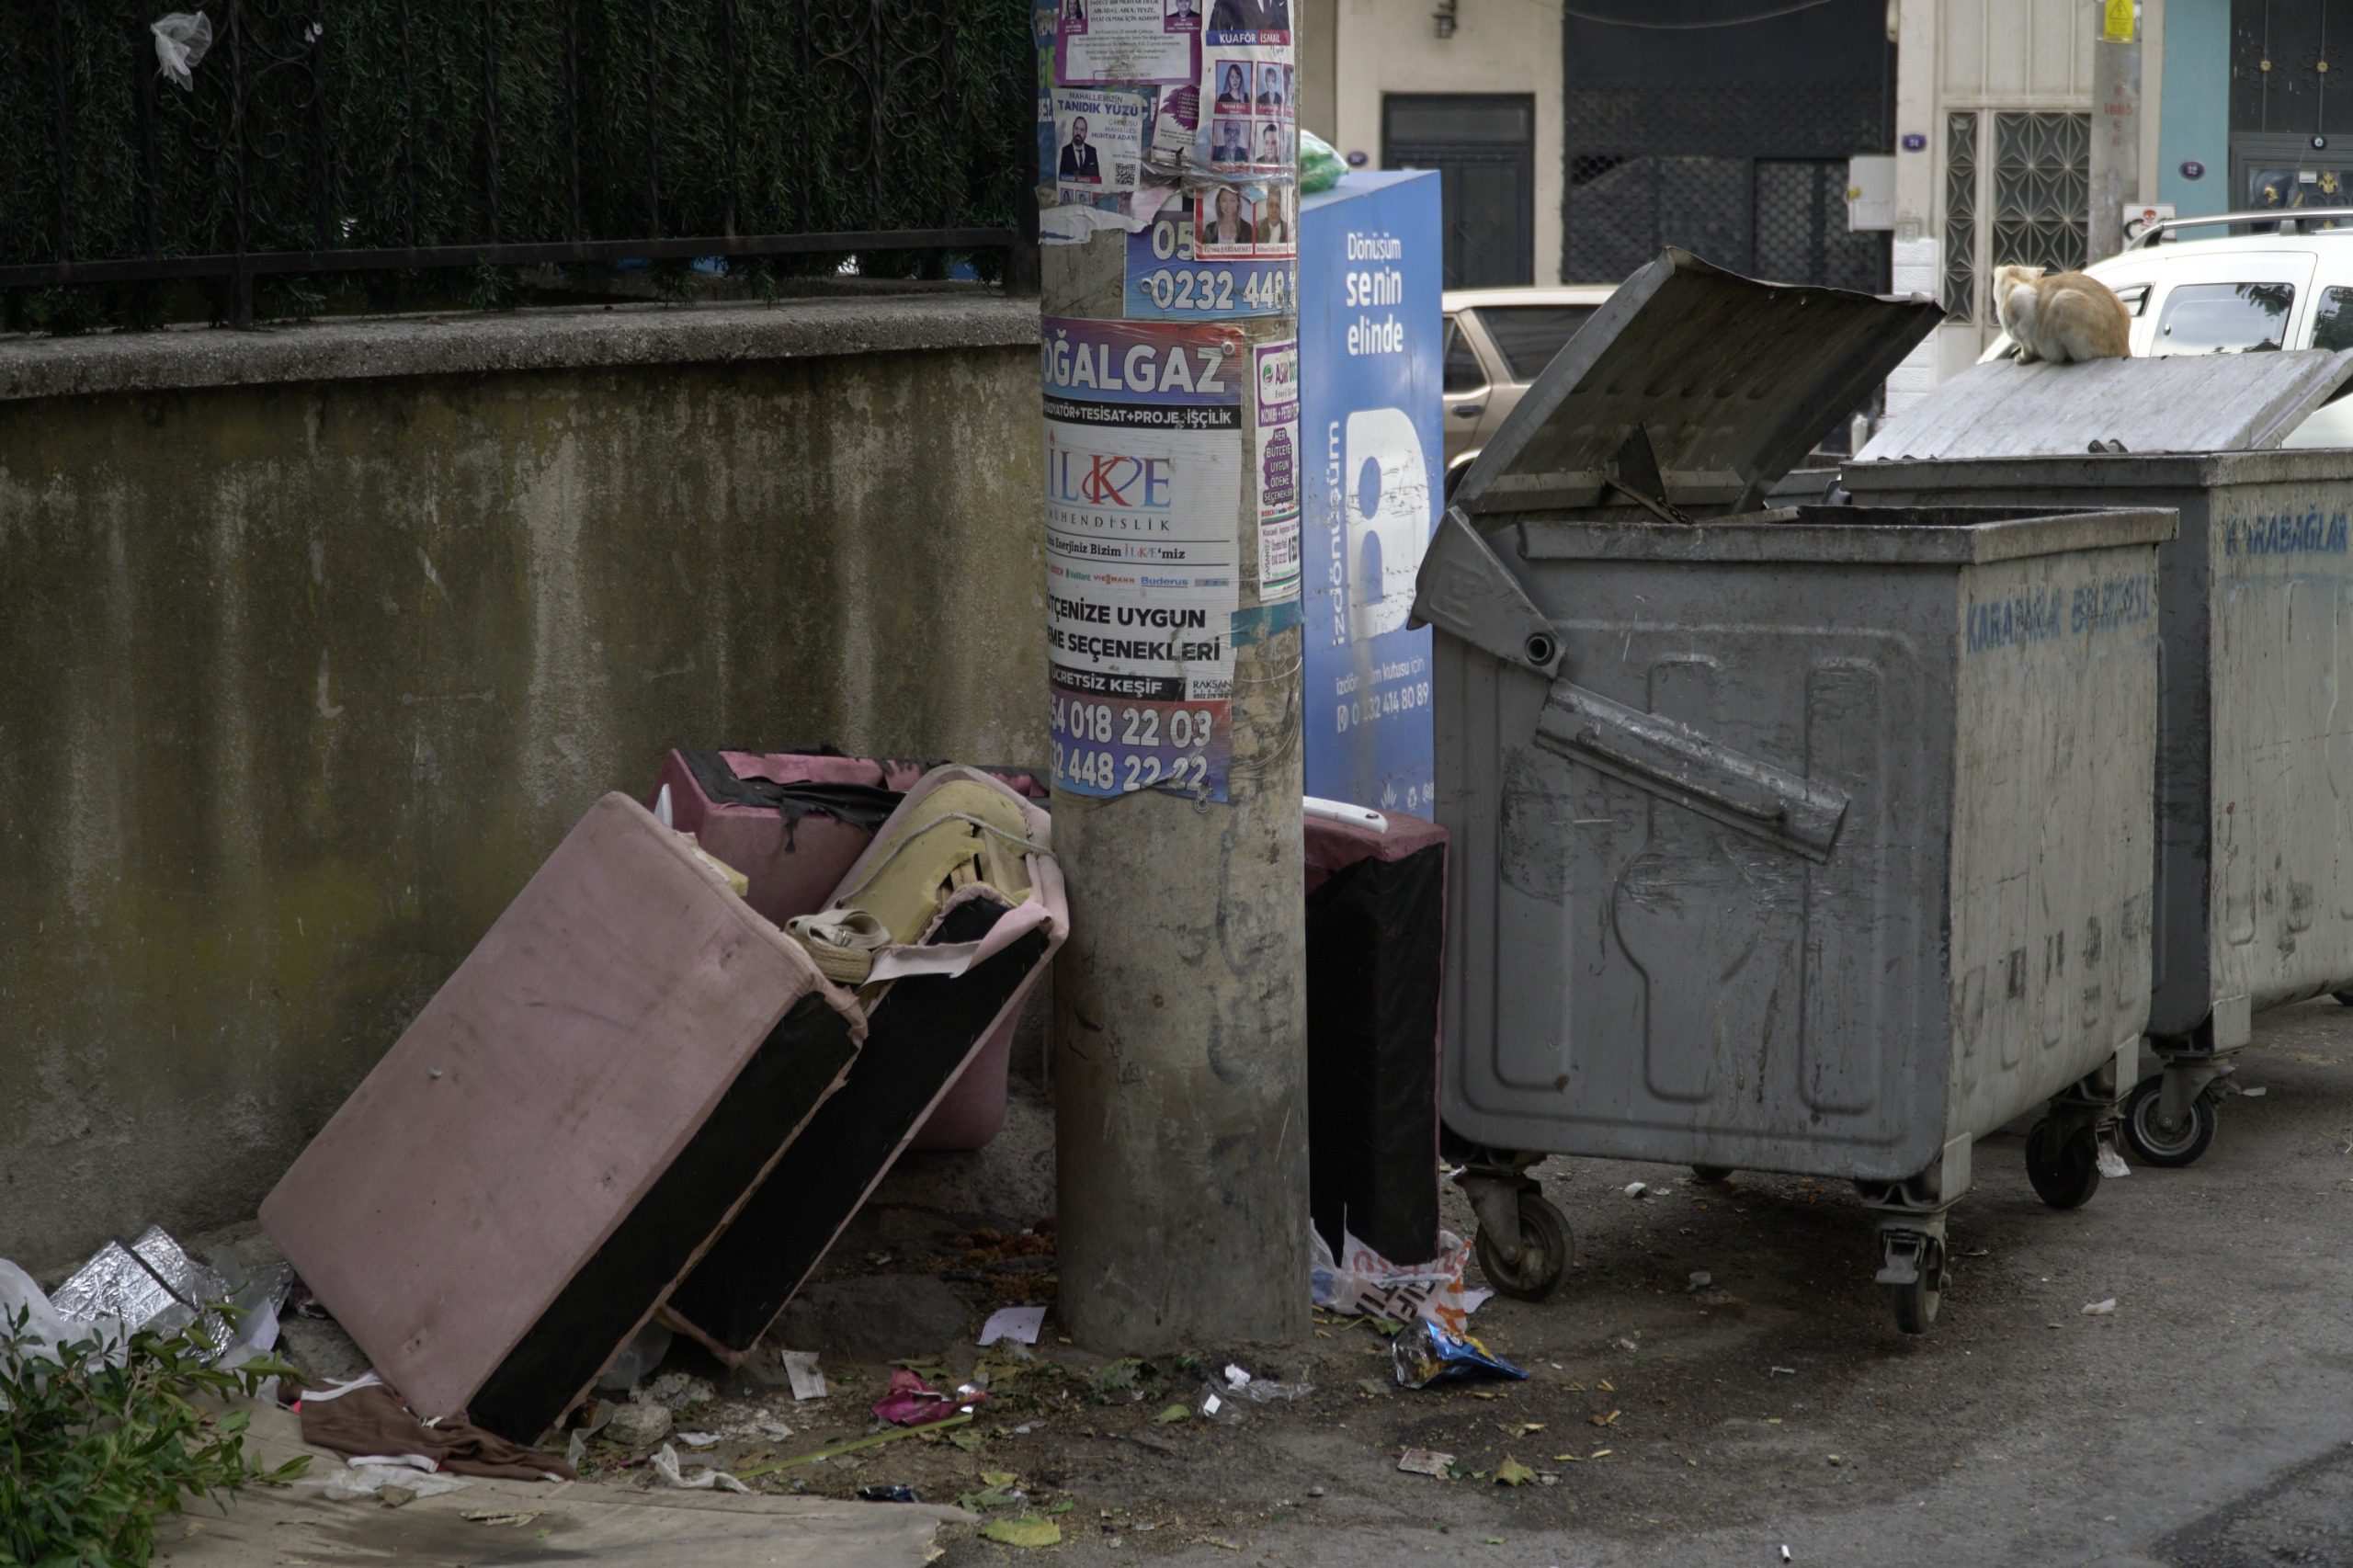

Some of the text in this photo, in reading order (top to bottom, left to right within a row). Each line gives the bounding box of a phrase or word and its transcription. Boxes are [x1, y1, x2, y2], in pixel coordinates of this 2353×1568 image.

[1219, 31, 1281, 44] KUAFÖR İSMAİL
[1057, 99, 1101, 114] TANIDIK
[1105, 103, 1139, 117] YÜZÜ
[1091, 132, 1116, 141] MUHTAR
[1347, 232, 1402, 263] Dönüşüm
[1151, 268, 1234, 311] 0232
[1243, 270, 1285, 310] 448
[1346, 267, 1403, 307] senin
[1347, 313, 1404, 356] elinde
[1274, 430, 1286, 441] HER
[1048, 428, 1172, 508] İLKE
[1270, 461, 1290, 472] UYGUN
[1270, 474, 1290, 487] ÖDEME
[1325, 421, 1346, 646] izdönüşüm
[1090, 543, 1121, 557] Bizim
[1069, 569, 1091, 582] Vaillant
[1141, 575, 1188, 586] Buderus
[1117, 607, 1206, 629] UYGUN
[1068, 633, 1221, 663] SEÇENEKLERİ
[1382, 661, 1410, 681] kutusu
[1109, 677, 1163, 698] KEŞİF
[1192, 678, 1233, 689] RAKSAN
[1352, 702, 1359, 726] 0
[1383, 690, 1400, 715] 414
[1401, 686, 1415, 710] 80
[1416, 681, 1429, 707] 89
[1070, 700, 1113, 744] 018
[1121, 707, 1160, 746] 22
[1169, 709, 1212, 748] 03
[1068, 748, 1114, 790] 448
[1122, 754, 1162, 791] 22
[1171, 755, 1208, 791] 22
